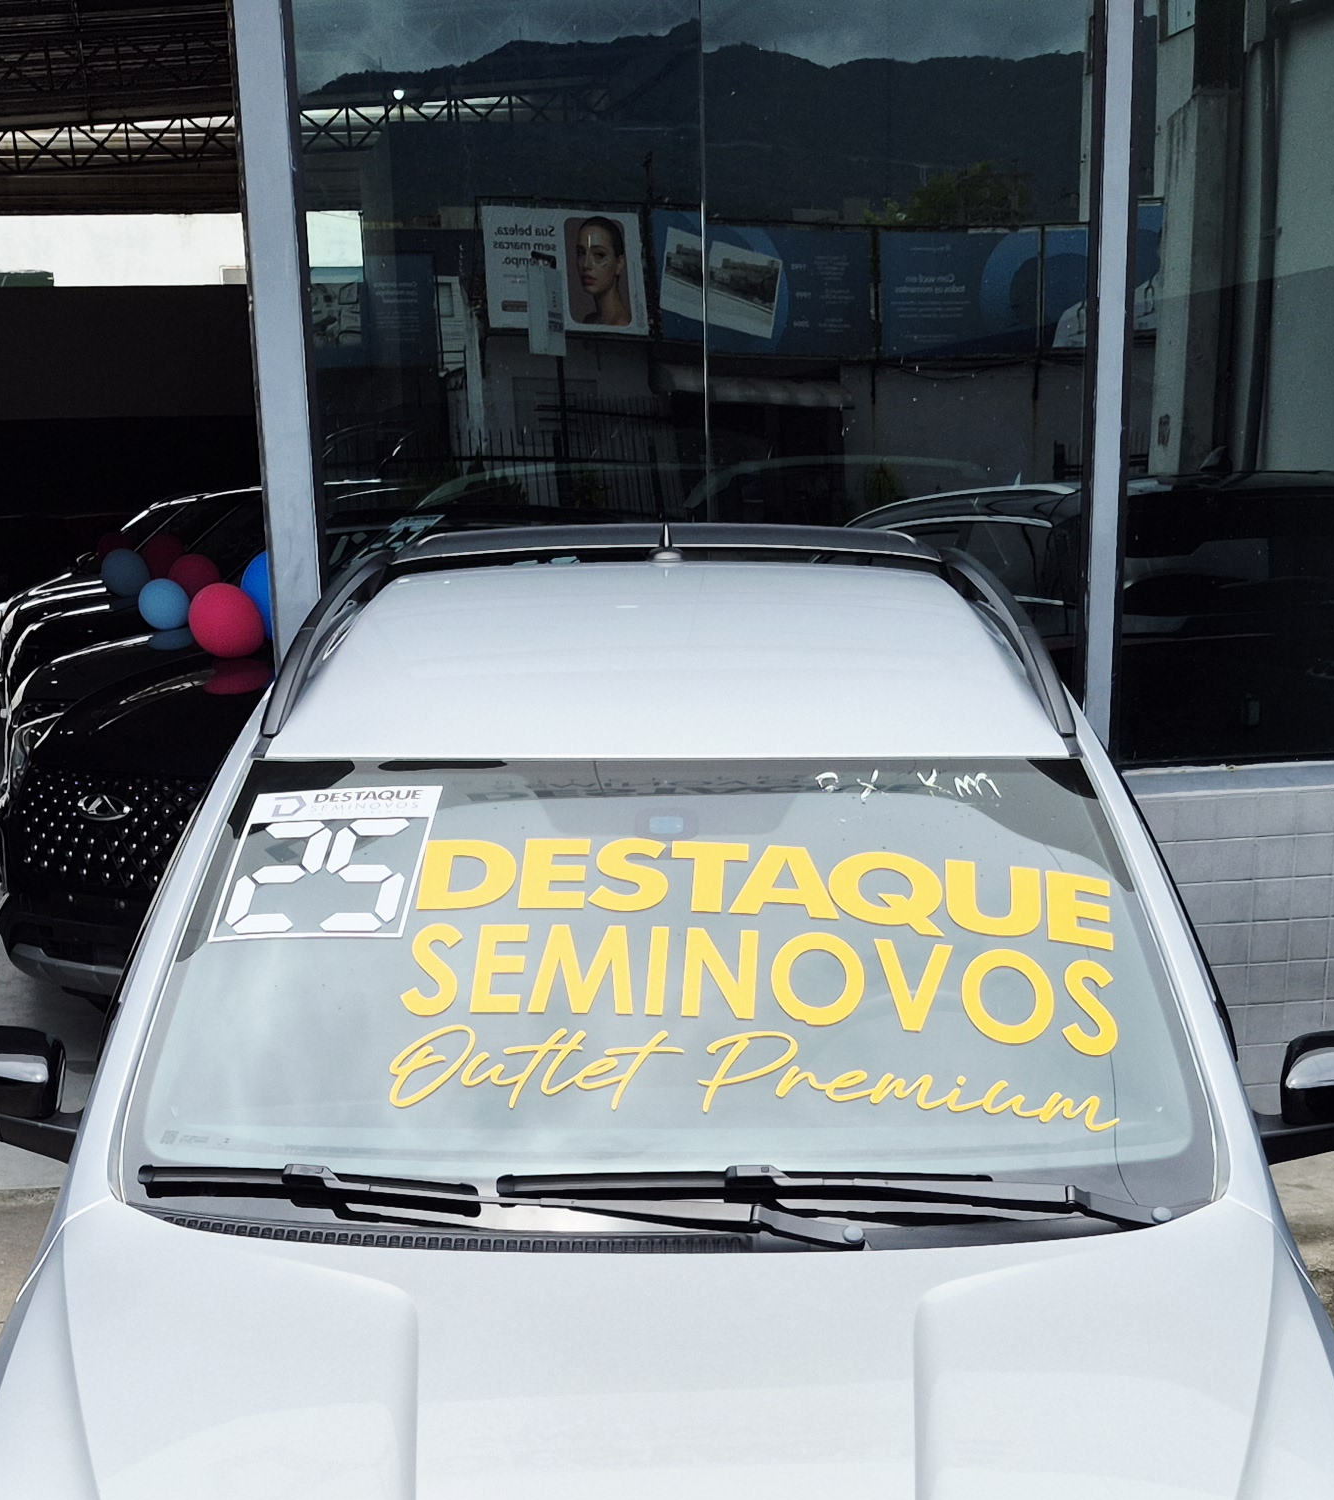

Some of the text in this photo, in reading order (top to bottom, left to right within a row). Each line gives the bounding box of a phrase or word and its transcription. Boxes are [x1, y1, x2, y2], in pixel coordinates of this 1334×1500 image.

[310, 800, 420, 812] SEMINOVOS
[313, 789, 423, 803] DESTAQUE
[416, 838, 1114, 951] DESTAQUE
[399, 923, 1118, 1056] SEMINOVOS
[389, 1024, 1120, 1131] Outlet Premium
